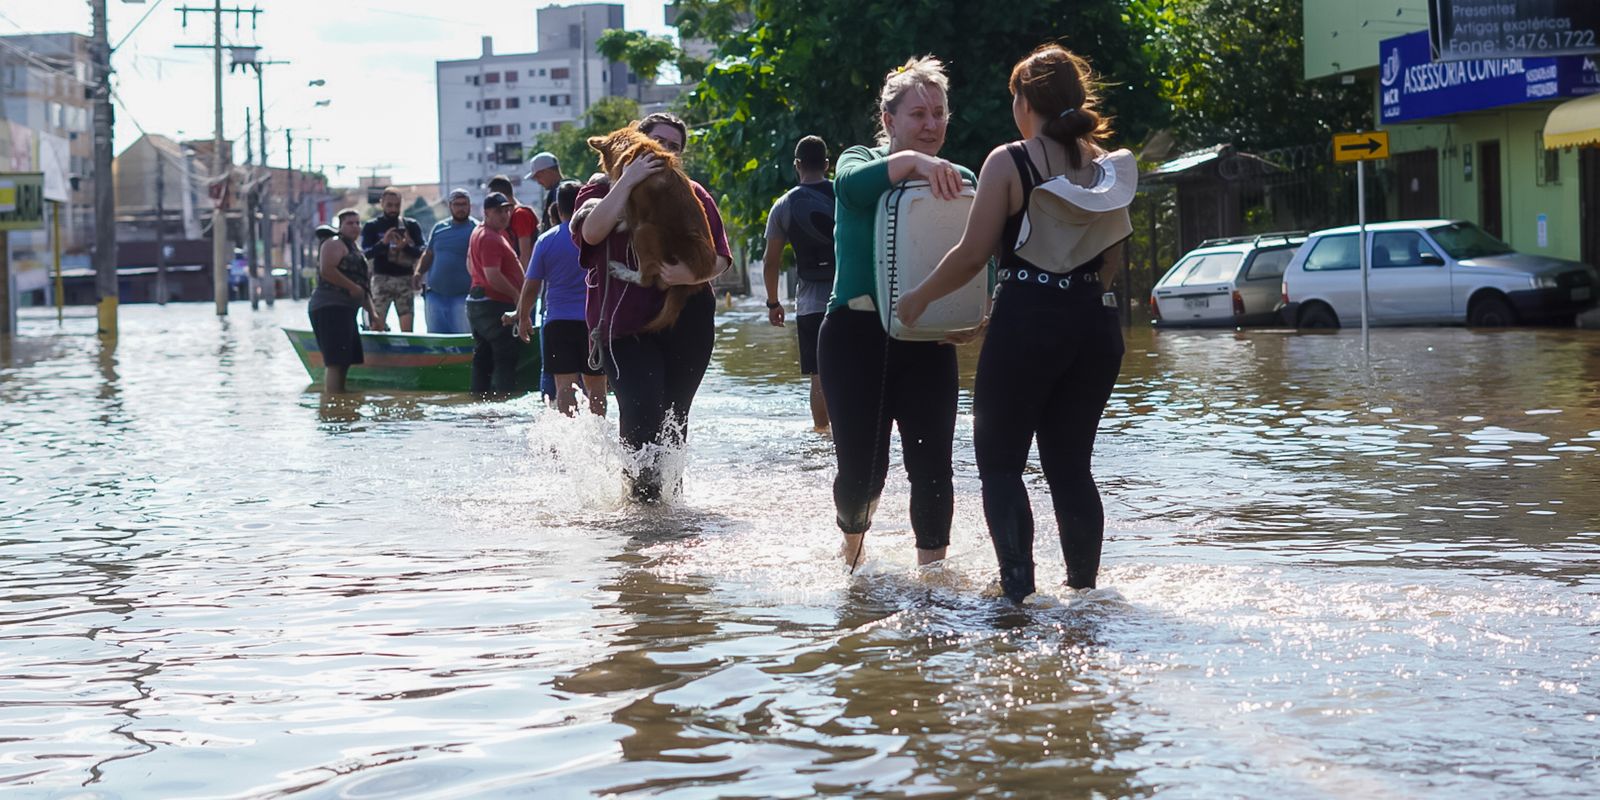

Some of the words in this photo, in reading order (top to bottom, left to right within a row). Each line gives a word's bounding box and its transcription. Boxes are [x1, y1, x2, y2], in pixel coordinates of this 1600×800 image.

[1452, 4, 1516, 17] Presentes
[1454, 22, 1499, 36] Artigos
[1449, 38, 1500, 54] Fone:
[1505, 30, 1596, 51] 3476.1722
[1403, 61, 1467, 94] ASSESSORIA
